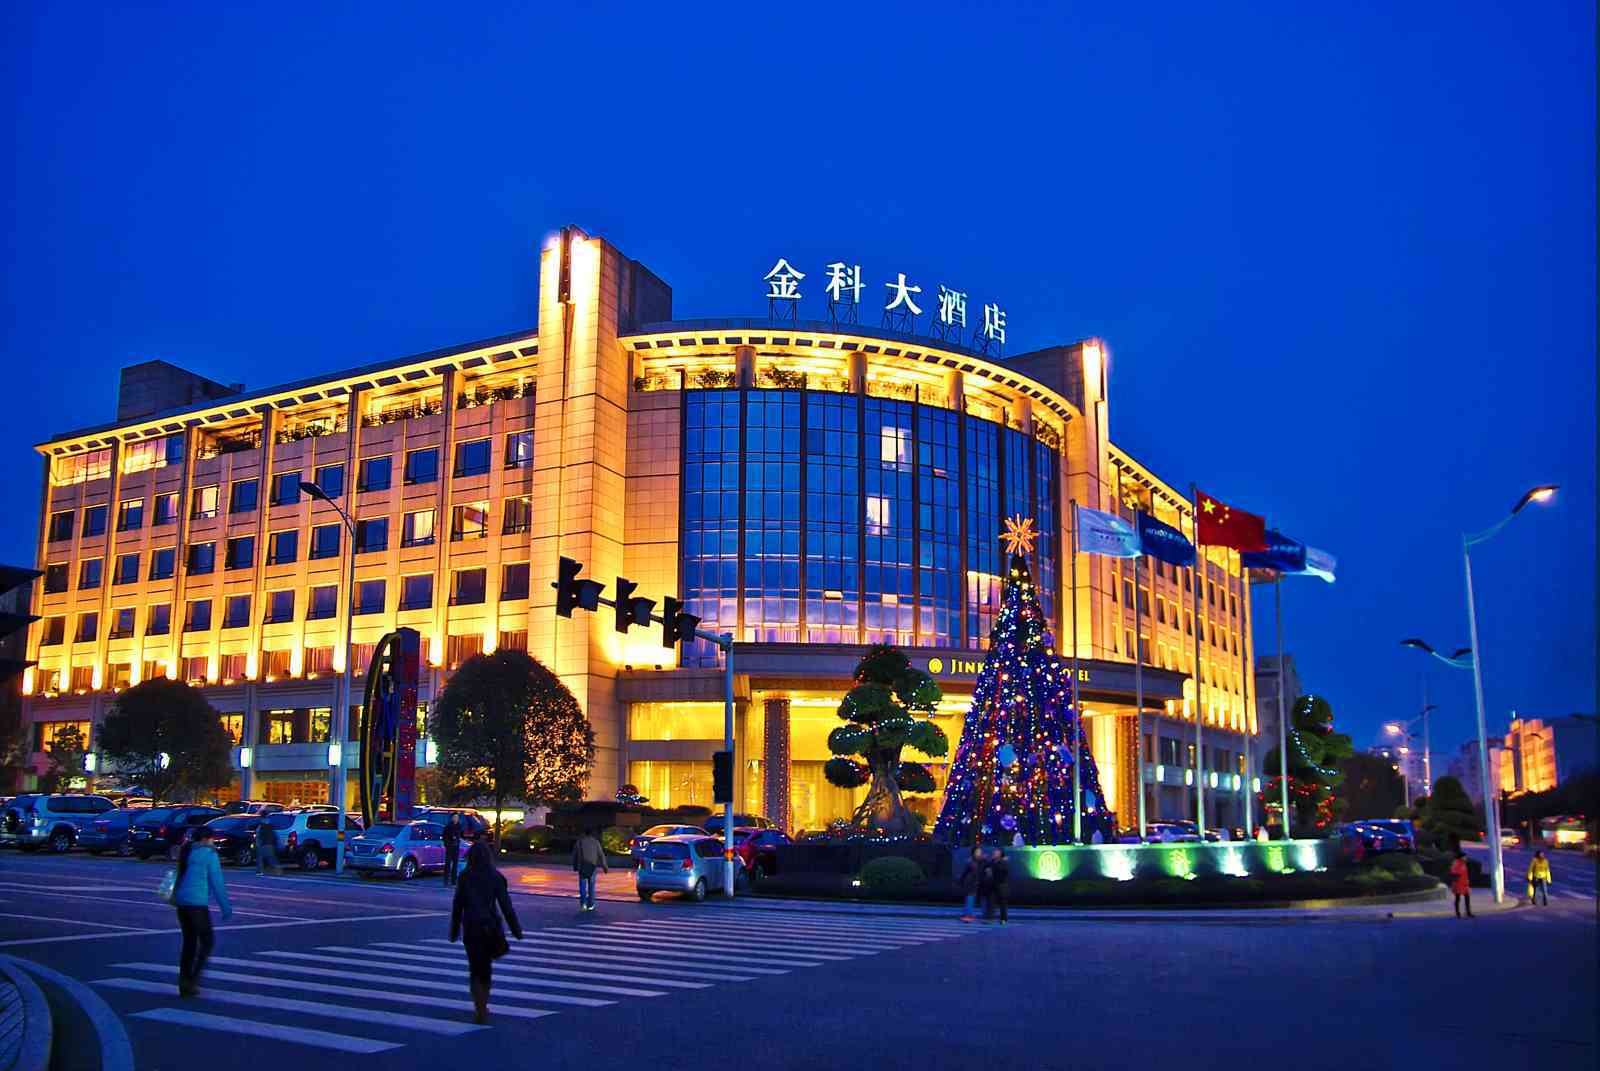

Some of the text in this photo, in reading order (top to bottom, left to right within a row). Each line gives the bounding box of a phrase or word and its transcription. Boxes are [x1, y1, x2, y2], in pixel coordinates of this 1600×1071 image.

[763, 258, 1007, 344] 金科大酒店
[951, 659, 986, 674] JINK
